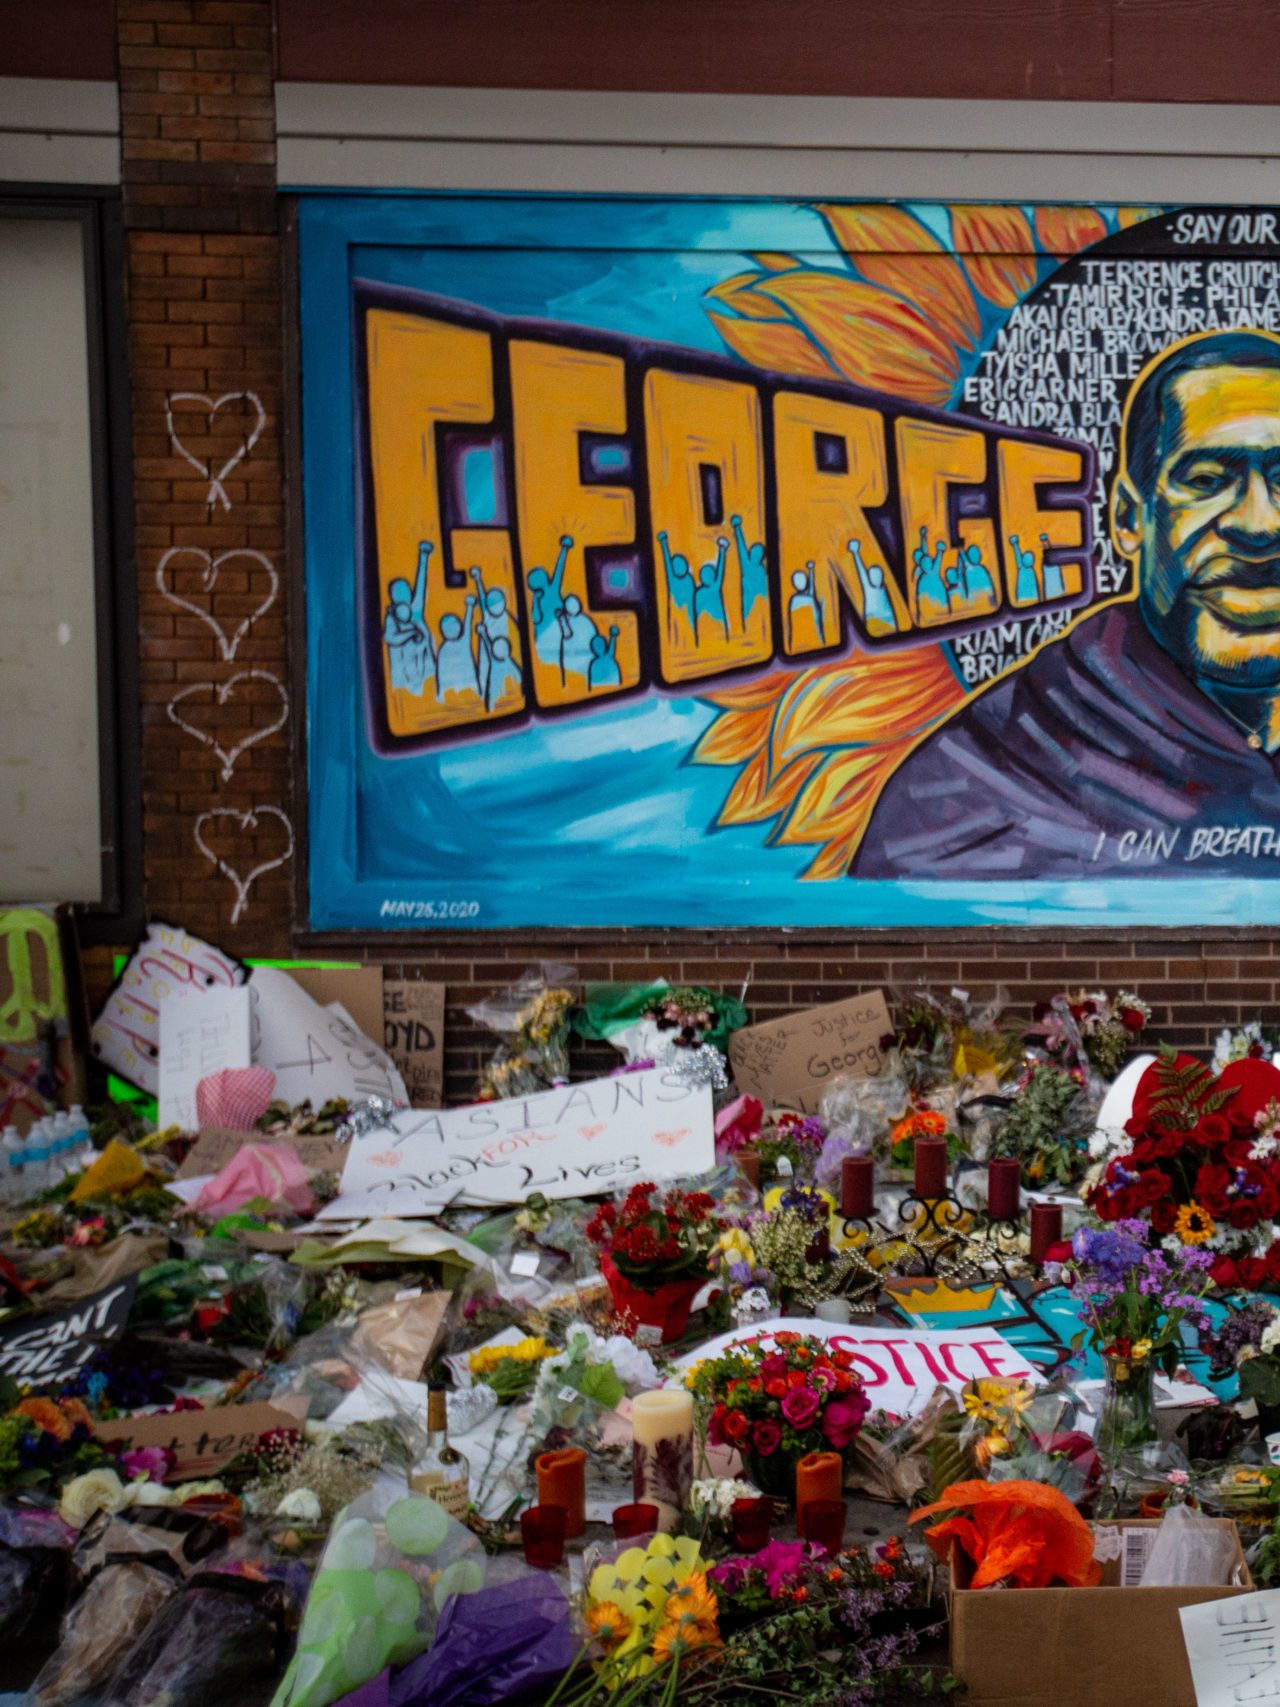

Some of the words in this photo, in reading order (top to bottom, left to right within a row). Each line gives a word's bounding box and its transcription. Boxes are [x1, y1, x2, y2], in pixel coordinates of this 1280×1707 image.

[1173, 214, 1230, 245] SAY
[1231, 215, 1280, 245] OUR
[1081, 261, 1203, 287] TERRENCE
[1051, 284, 1125, 307] TAMIR
[1126, 286, 1186, 310] RICE
[1008, 305, 1057, 330] AKAI
[997, 329, 1098, 353] MICHAEL
[981, 351, 1060, 380] TYISHA
[1069, 354, 1143, 380] MILLE
[981, 402, 1075, 427] SANDRA
[358, 295, 1090, 748] GEORGE
[1092, 831, 1107, 862] I
[1117, 827, 1182, 862] CAN
[812, 1008, 881, 1037] Justice
[392, 1074, 693, 1148] ASIANS
